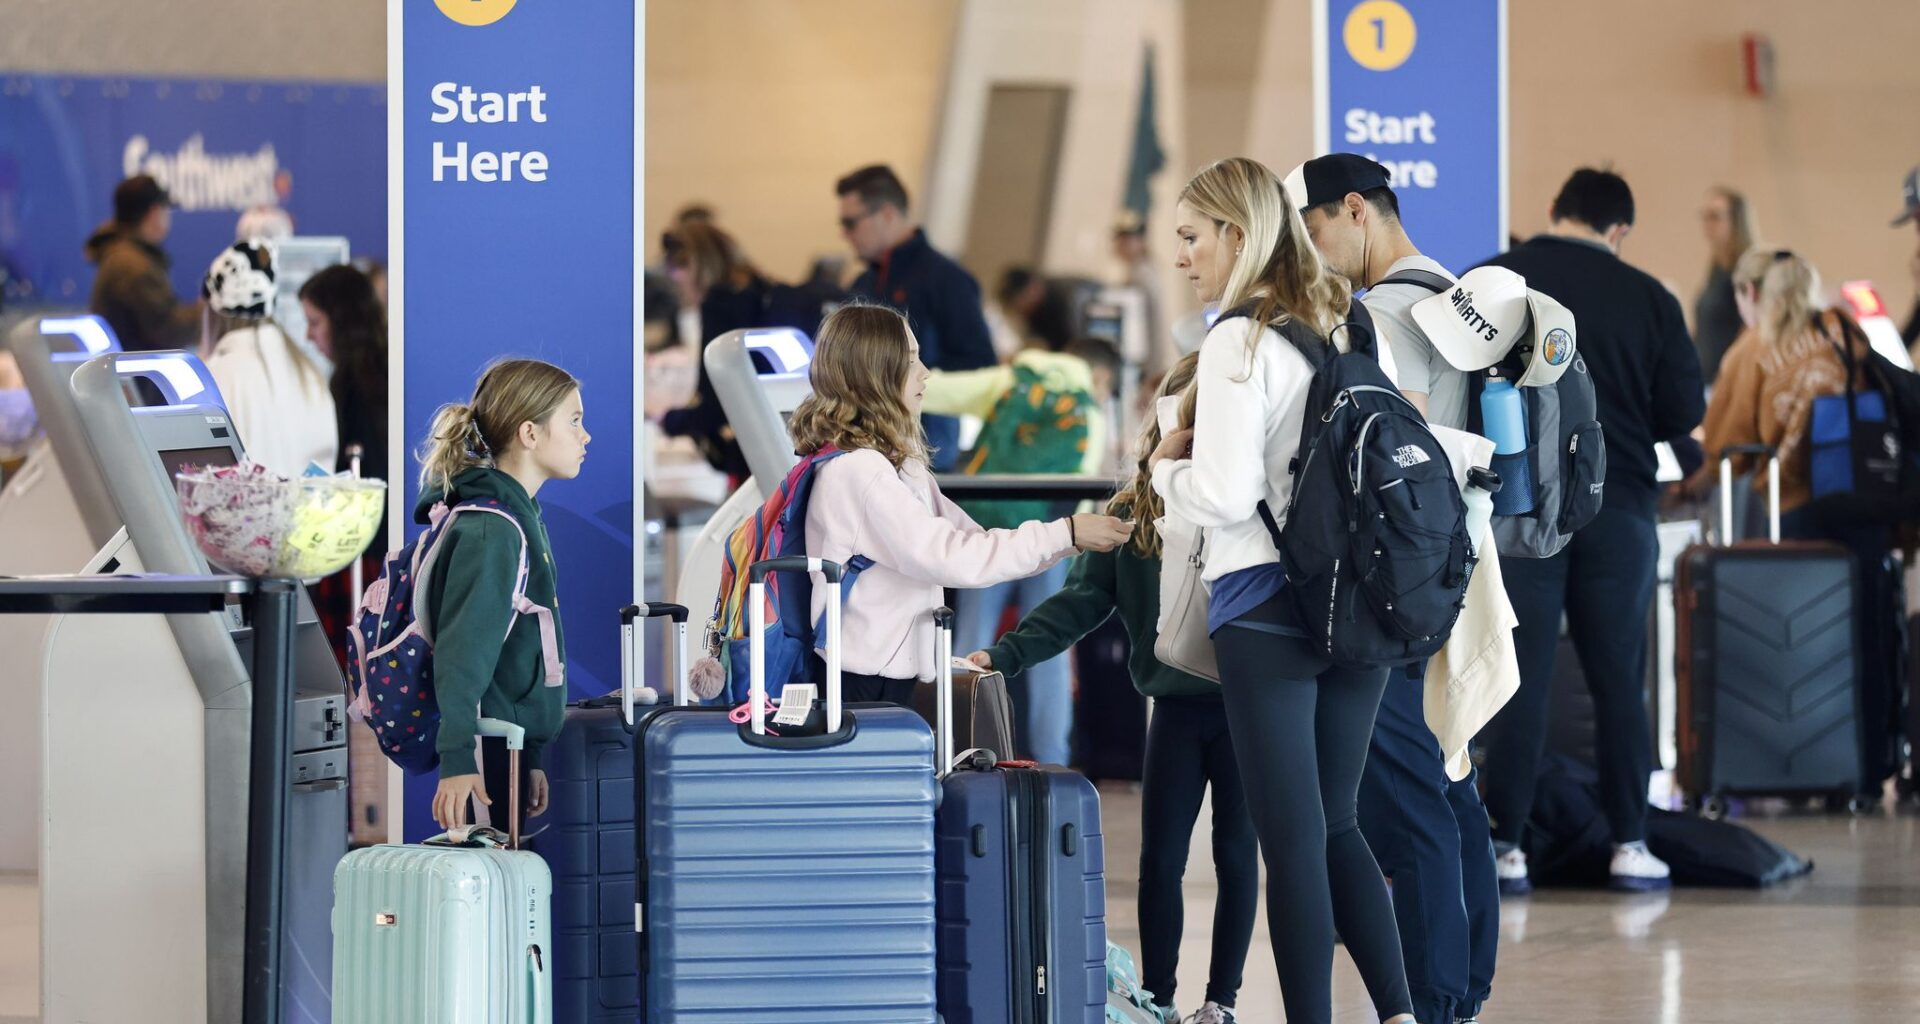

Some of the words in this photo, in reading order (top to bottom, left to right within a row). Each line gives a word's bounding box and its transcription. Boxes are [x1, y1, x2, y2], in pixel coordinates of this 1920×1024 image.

[1370, 18, 1385, 51] 1
[431, 81, 548, 124] Start
[1344, 107, 1437, 144] Start
[432, 141, 549, 182] Here
[1364, 152, 1438, 189] ere
[1396, 444, 1412, 454] THE
